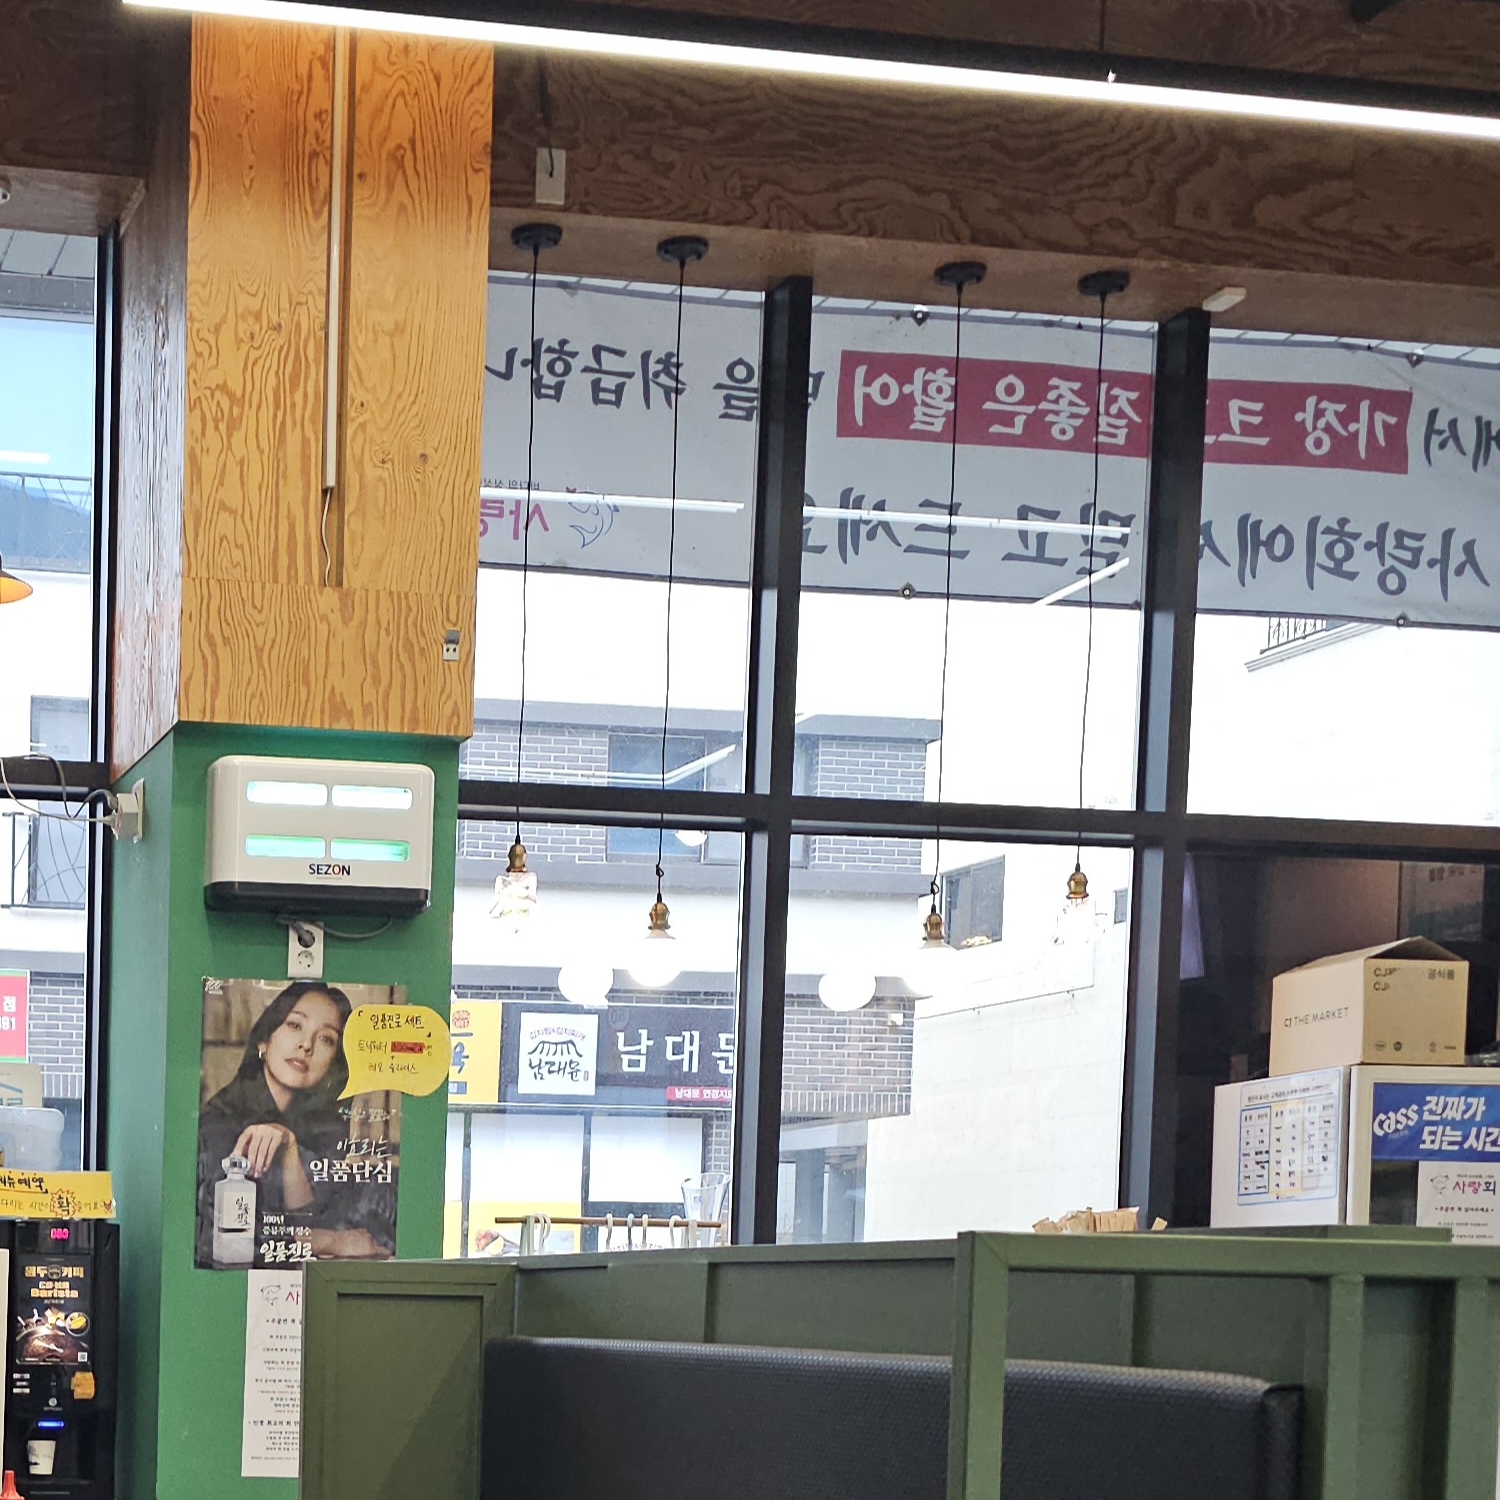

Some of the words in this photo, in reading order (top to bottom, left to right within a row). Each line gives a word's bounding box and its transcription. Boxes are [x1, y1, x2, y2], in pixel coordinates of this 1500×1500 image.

[308, 863, 351, 876] SEZON
[370, 1013, 402, 1031] 일품진로
[404, 1015, 425, 1029] 세트
[1293, 1013, 1310, 1026] THE
[1312, 1006, 1349, 1023] MARKET
[1422, 1095, 1487, 1122] 진짜가
[337, 1135, 392, 1158] 이효리는
[1419, 1124, 1463, 1151] 되는
[309, 1159, 393, 1184] 일품단심
[1452, 1180, 1497, 1196] 사랑회
[260, 1240, 318, 1263] 일품진로
